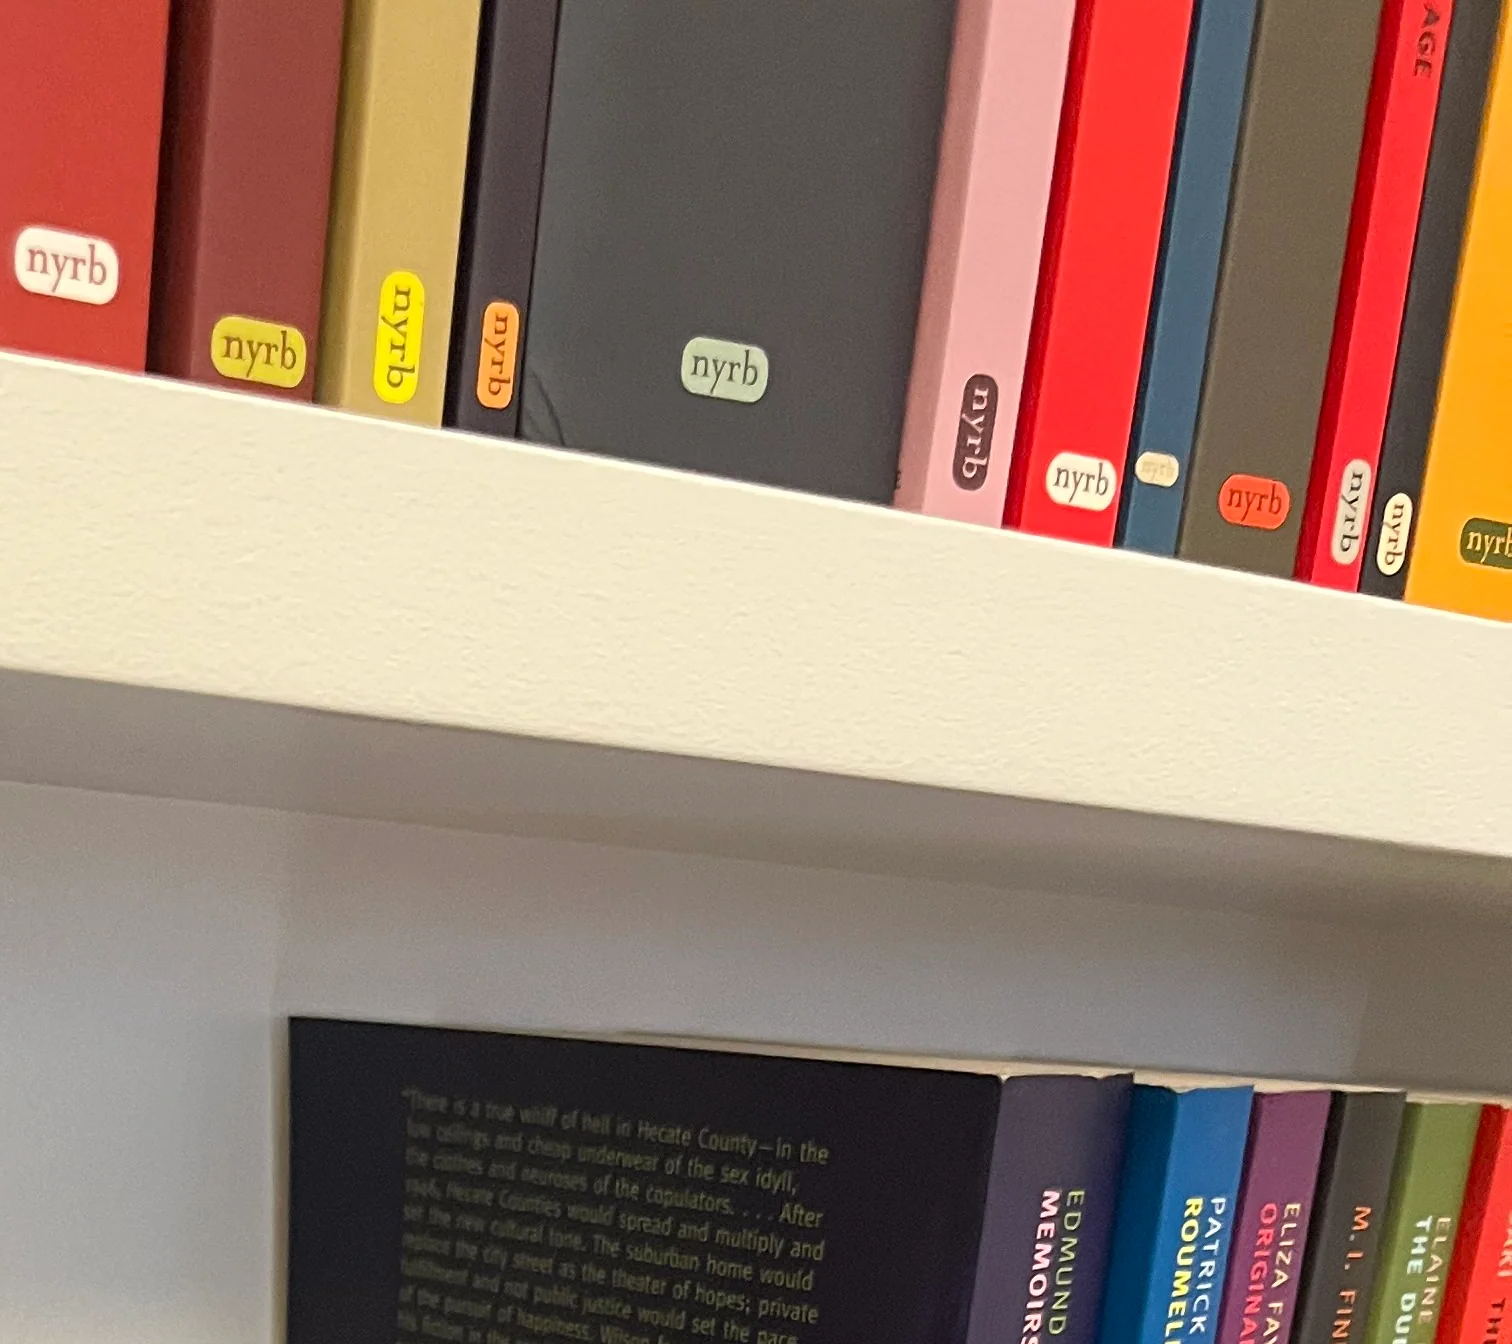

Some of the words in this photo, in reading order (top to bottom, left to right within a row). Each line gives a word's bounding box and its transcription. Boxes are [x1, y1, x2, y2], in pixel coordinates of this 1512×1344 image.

[26, 244, 107, 297] nyrb
[220, 331, 296, 380] nyrb
[378, 283, 412, 389] nyrb
[480, 312, 509, 396] nyrb
[692, 349, 759, 393] nyrb
[959, 386, 989, 478] nyrb
[1052, 461, 1110, 502] nyrb
[1226, 484, 1282, 518] nyrb
[1338, 468, 1364, 552] nyrb
[1383, 501, 1404, 565] nyrb
[1047, 1189, 1084, 1336] EDMUND
[1189, 1197, 1225, 1334] PATRICK
[1269, 1202, 1300, 1288] ELIZA
[1406, 1214, 1432, 1274] THE
[1416, 1216, 1450, 1325] ELAINE
